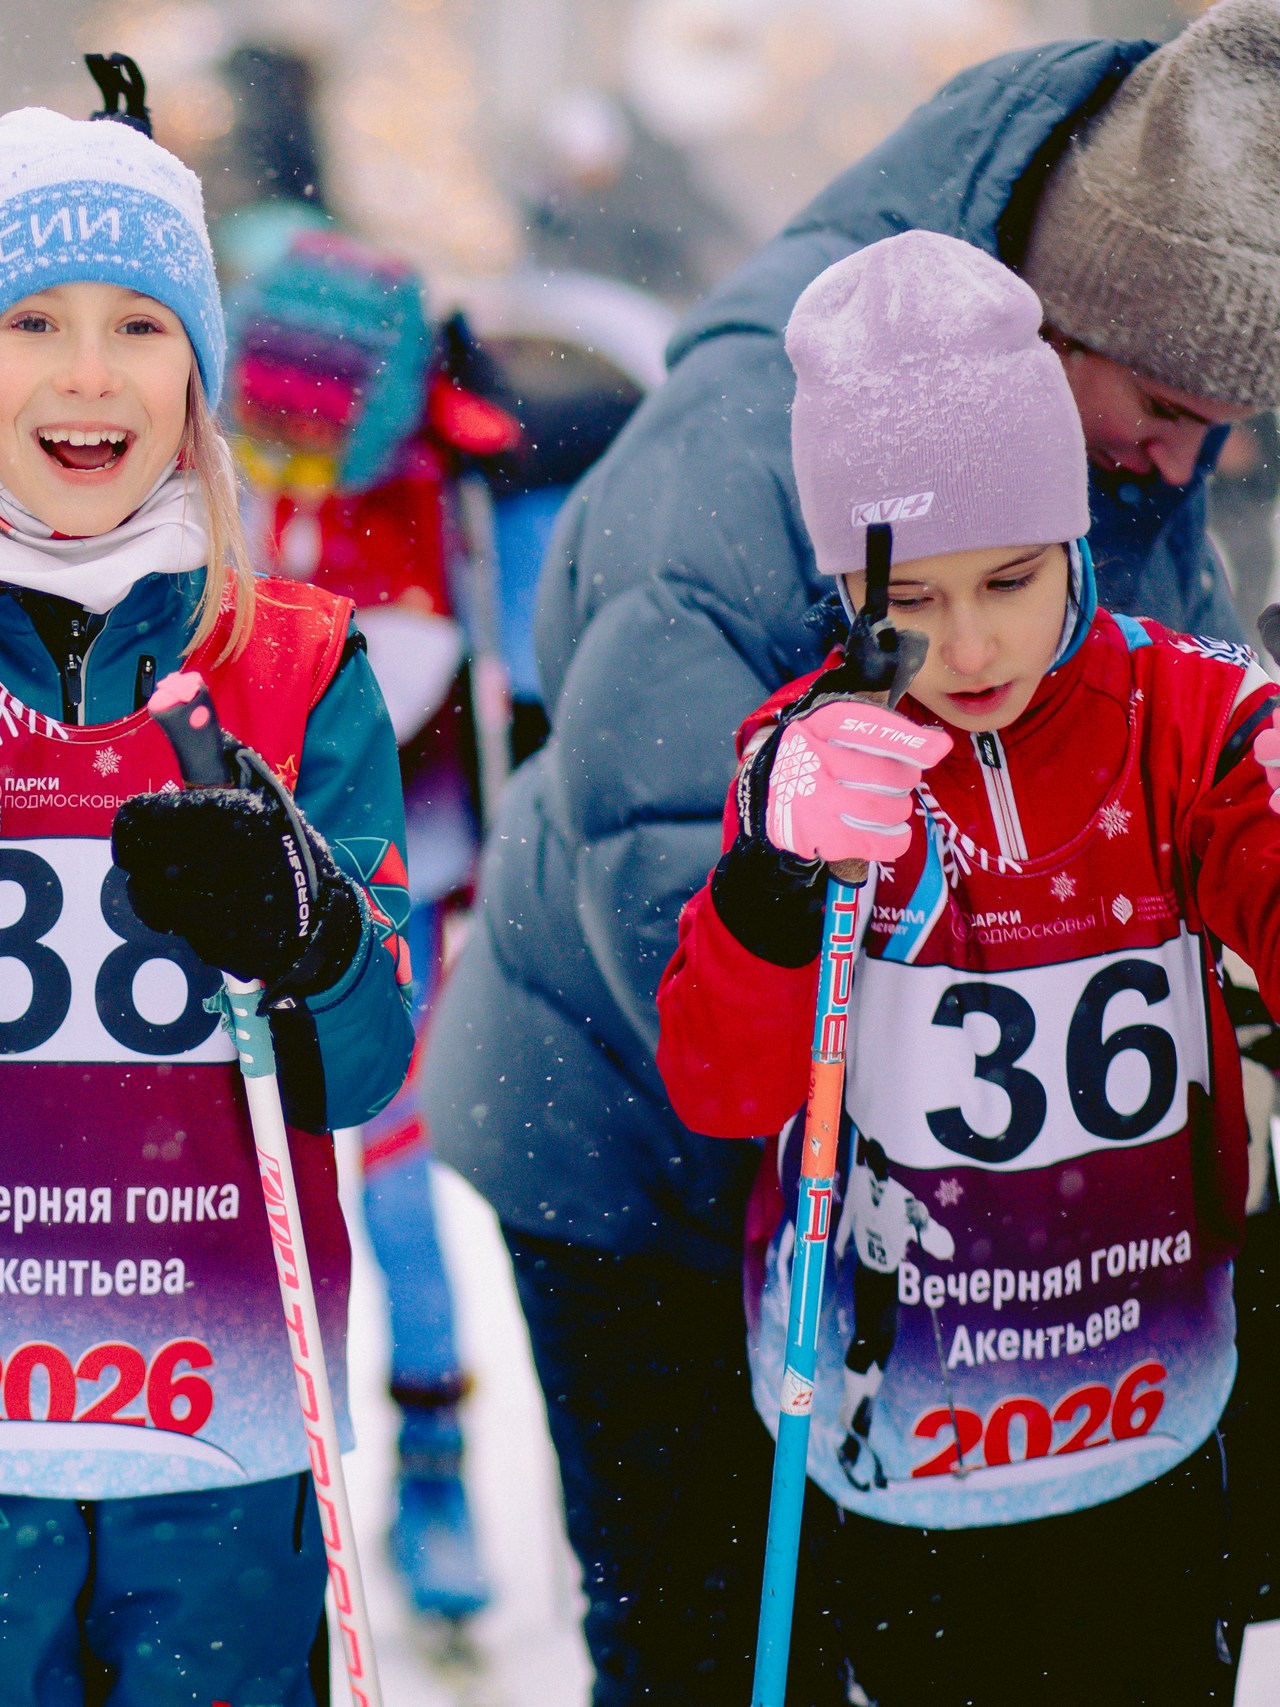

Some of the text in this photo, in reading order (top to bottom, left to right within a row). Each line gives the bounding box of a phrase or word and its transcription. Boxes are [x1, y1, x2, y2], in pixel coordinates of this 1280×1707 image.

[852, 493, 934, 526] KV+
[839, 717, 928, 750] SKI TIME
[4, 777, 60, 792] ПАРКИ
[281, 833, 311, 938] NORDSKI
[977, 913, 1096, 945] ОДМОСКОВЬЯ
[925, 958, 1178, 1164] 36
[126, 1183, 240, 1223] гонка
[898, 1229, 1192, 1311] Вечерняя гонка
[947, 1298, 1141, 1370] Акентьева
[910, 1358, 1168, 1479] 2026
